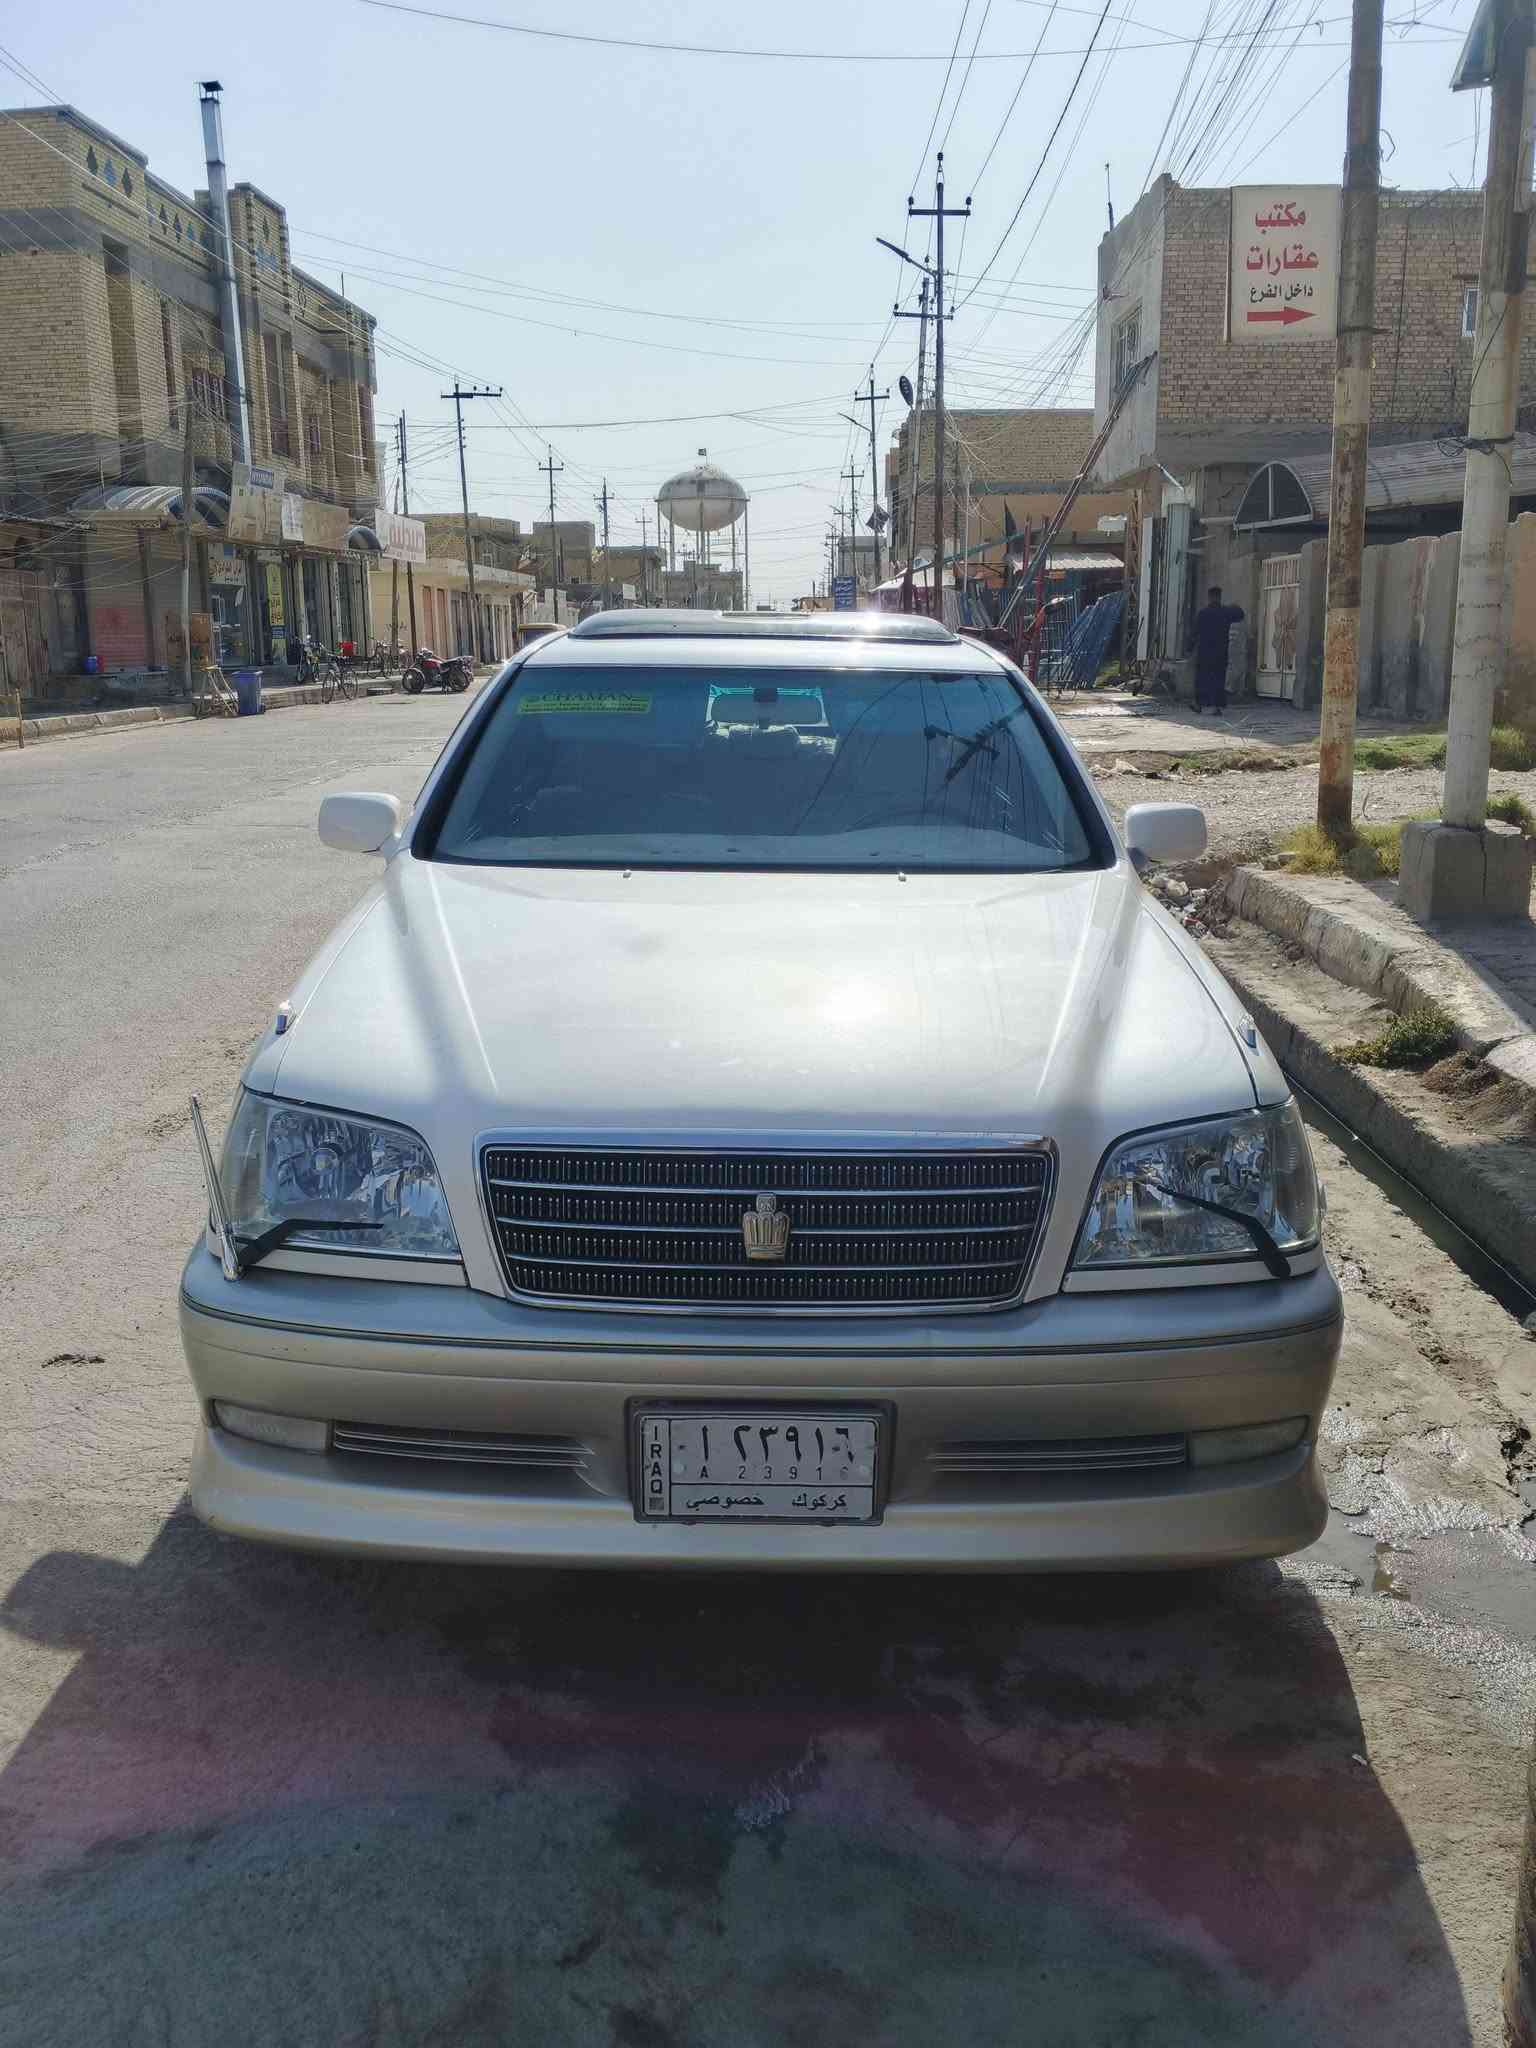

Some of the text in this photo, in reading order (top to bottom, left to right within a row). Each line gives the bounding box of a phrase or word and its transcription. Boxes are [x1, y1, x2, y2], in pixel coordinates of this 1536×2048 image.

[1255, 202, 1306, 235] مكتب
[1246, 244, 1320, 276] عقارات
[1250, 283, 1313, 303] داخل الفرع
[650, 1426, 663, 1494] IRAQ
[686, 1493, 848, 1511] كركوك خصوصي
